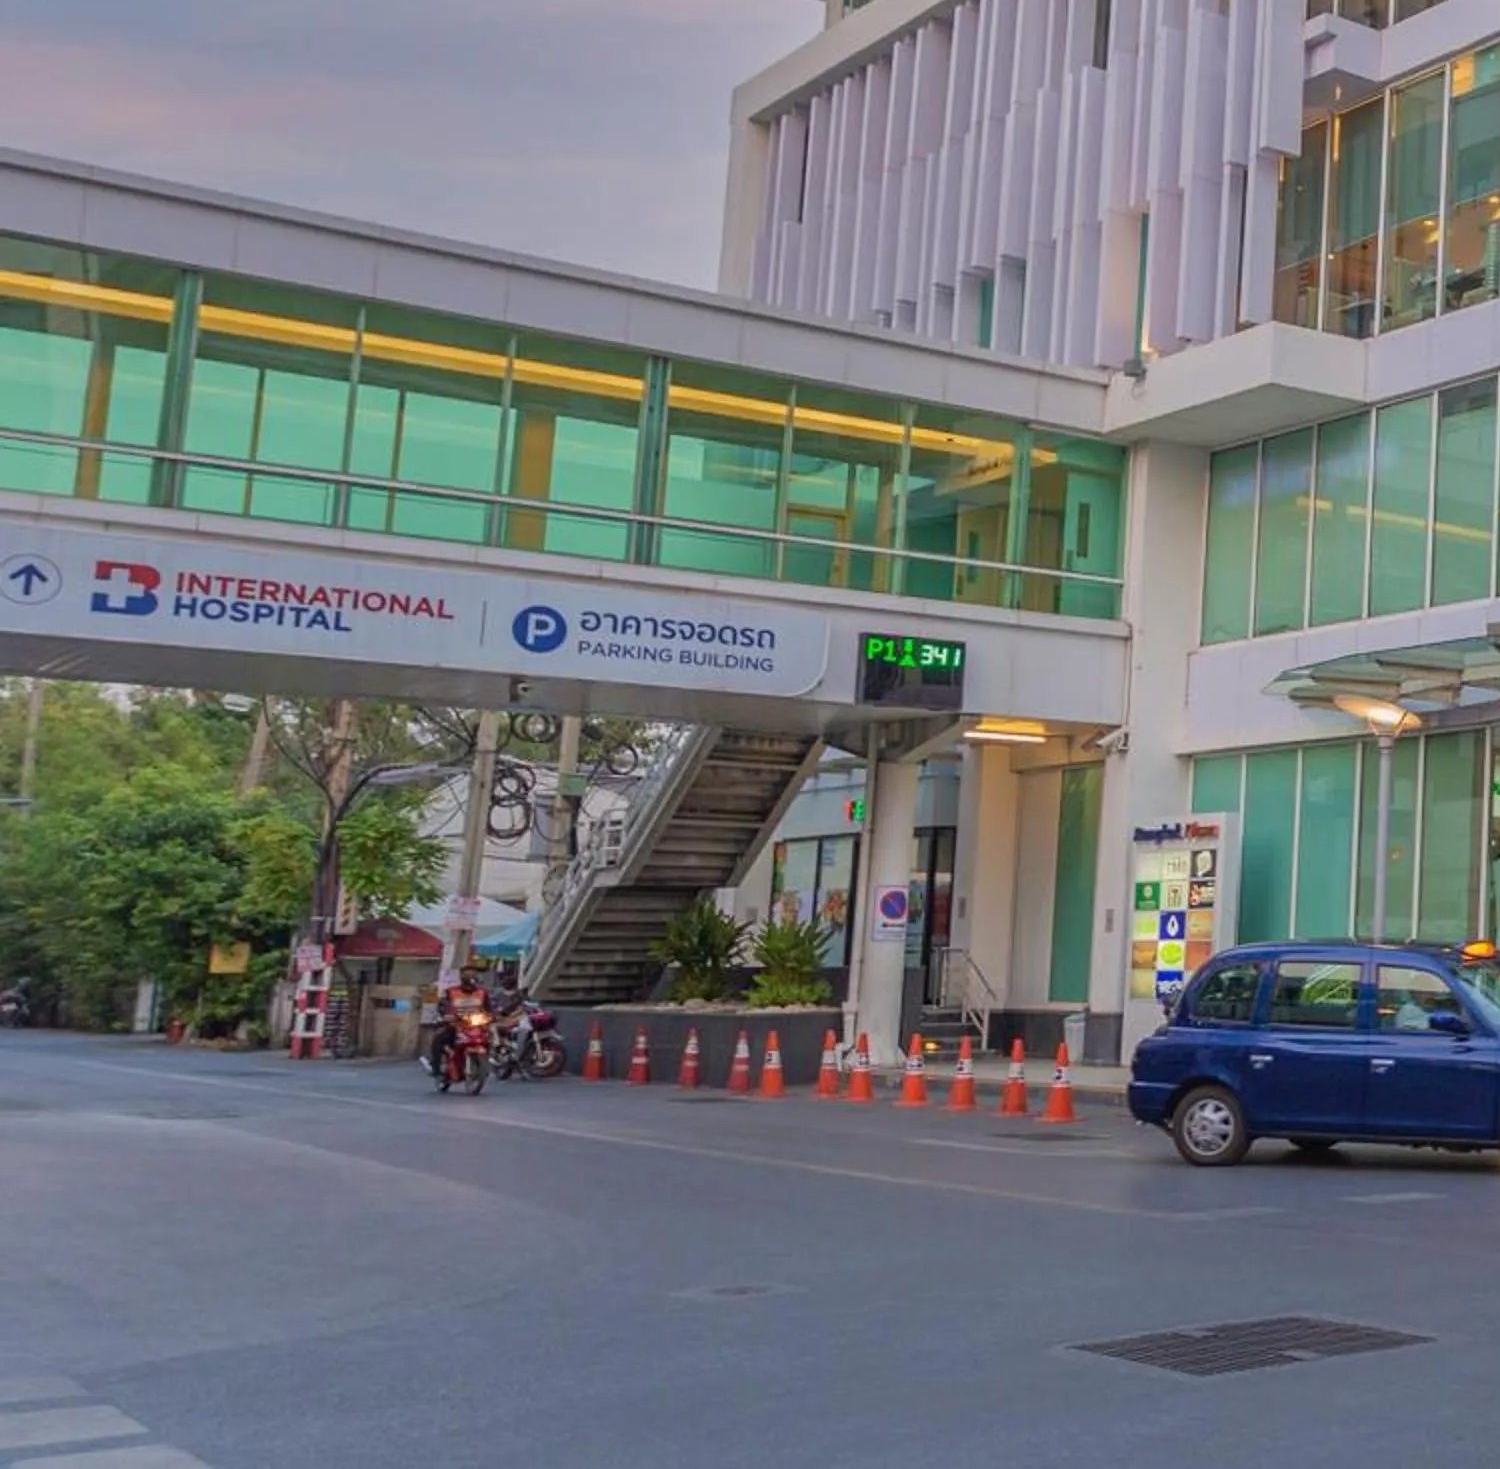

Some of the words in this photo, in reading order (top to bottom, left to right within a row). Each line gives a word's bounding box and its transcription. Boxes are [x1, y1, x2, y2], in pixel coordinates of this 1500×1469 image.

[176, 571, 455, 620] INTERNATIONAL
[173, 596, 352, 632] HOSPITAL
[579, 610, 775, 650] อาคารจอดรถ
[577, 640, 673, 663] PARKING
[678, 651, 774, 673] BUILDING
[867, 638, 897, 662] P1
